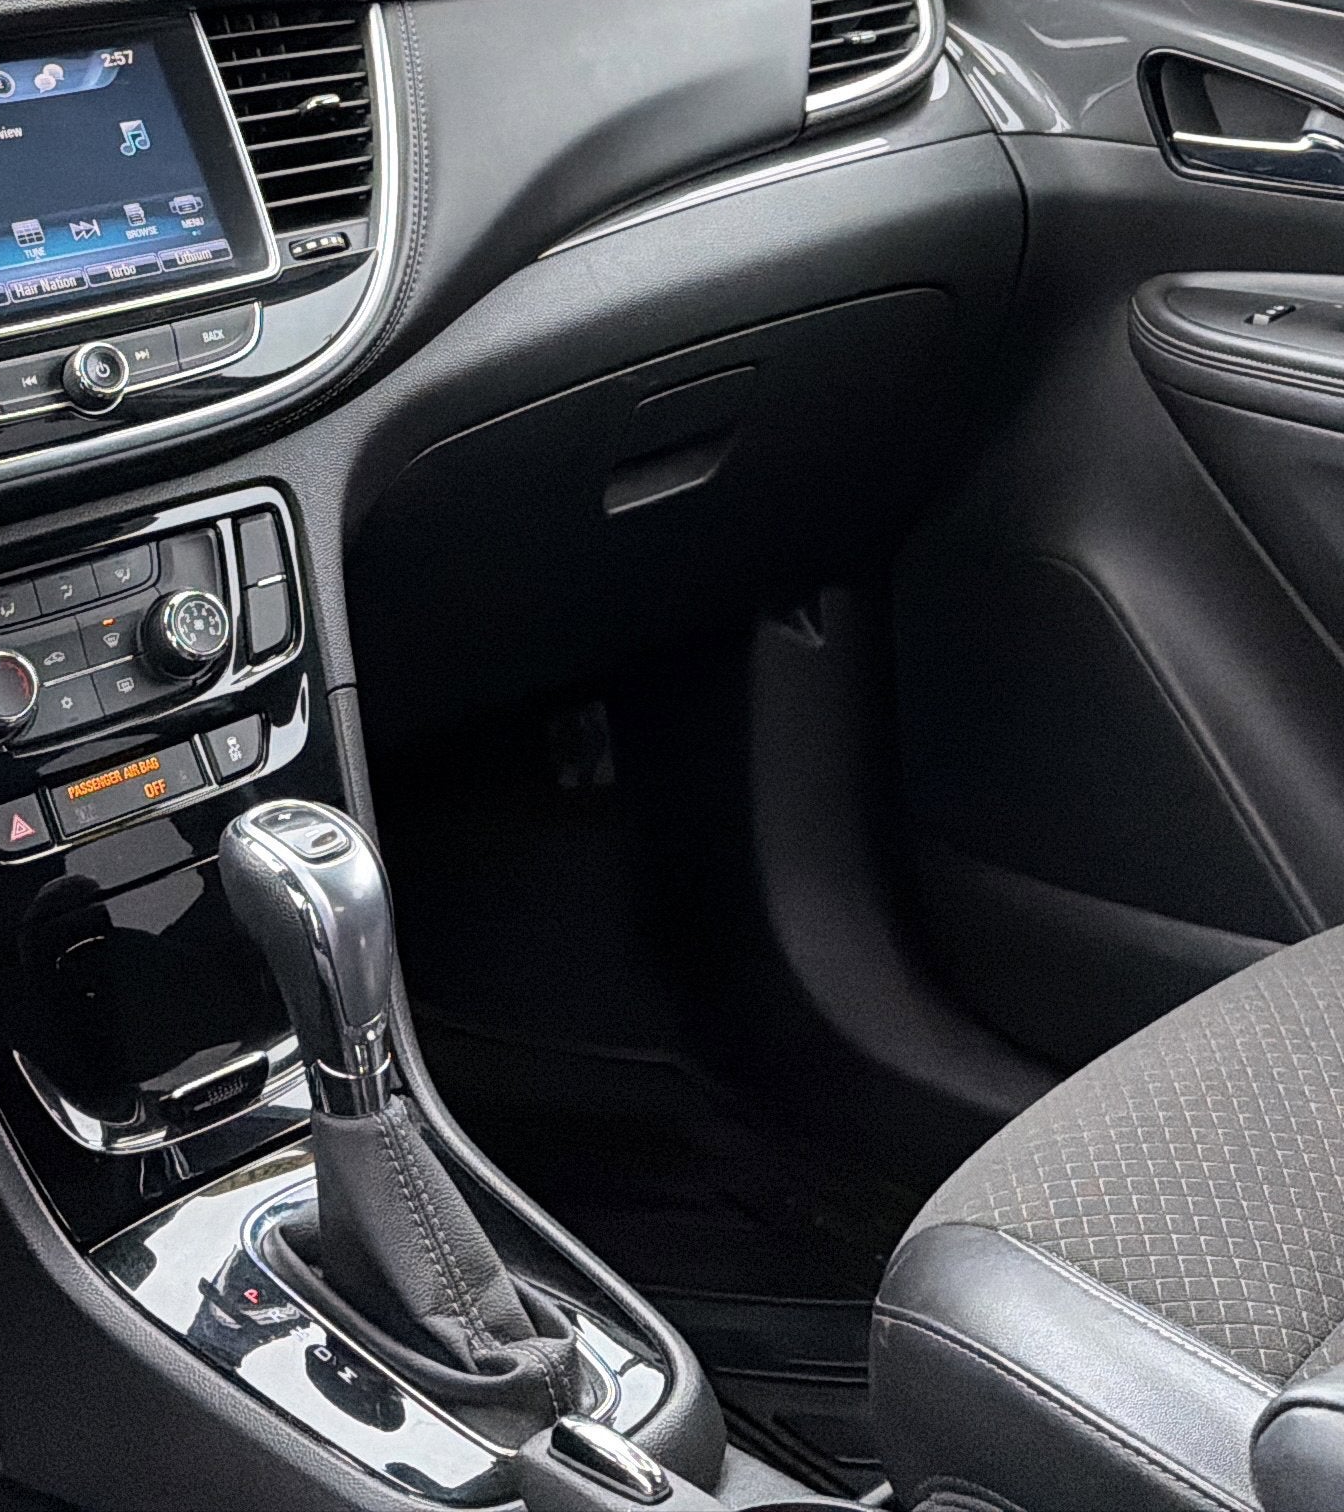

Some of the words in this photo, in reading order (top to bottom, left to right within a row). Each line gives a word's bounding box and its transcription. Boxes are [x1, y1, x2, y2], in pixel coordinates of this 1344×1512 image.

[101, 50, 134, 68] 2:57
[181, 217, 205, 229] MENU
[125, 226, 159, 239] BROWSE
[23, 246, 46, 259] TUNE
[174, 250, 212, 265] Lithium
[106, 264, 136, 280] Turbo
[14, 281, 39, 299] Hair
[41, 276, 77, 293] Nation
[202, 328, 227, 343] BACK
[67, 769, 123, 800] PASSENGER
[143, 778, 167, 799] OFF
[243, 1288, 259, 1305] P
